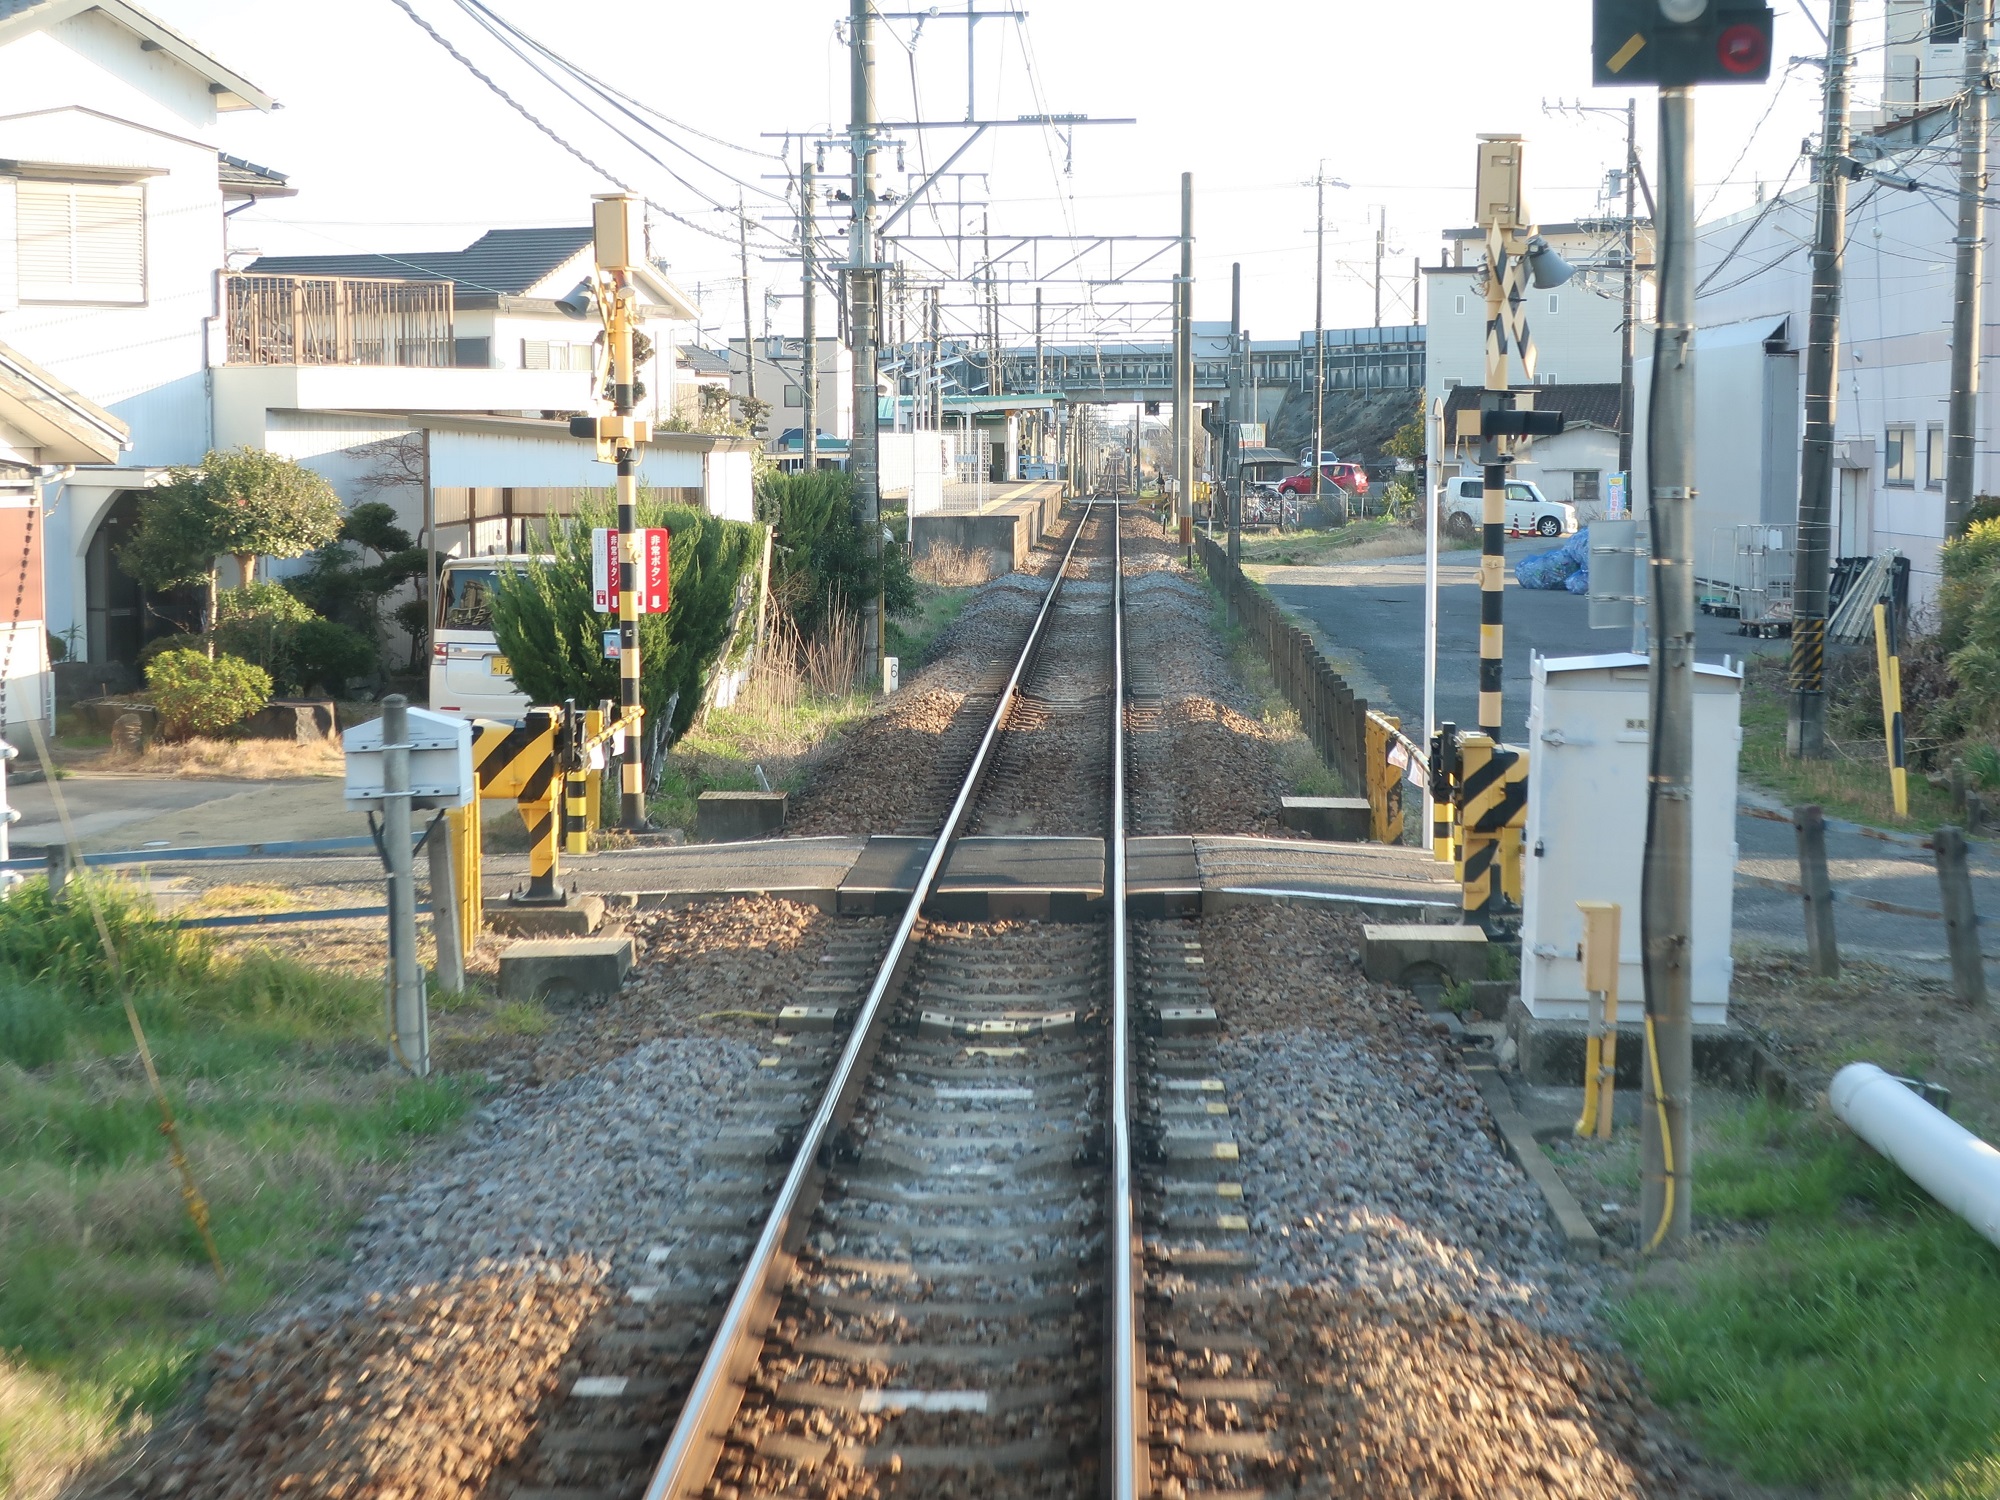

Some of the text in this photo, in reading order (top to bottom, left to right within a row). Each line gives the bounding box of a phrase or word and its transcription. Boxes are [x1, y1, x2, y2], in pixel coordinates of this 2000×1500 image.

[610, 535, 618, 587] 非常ボタン
[650, 534, 661, 587] 非常ボタン
[891, 663, 898, 678] 6
